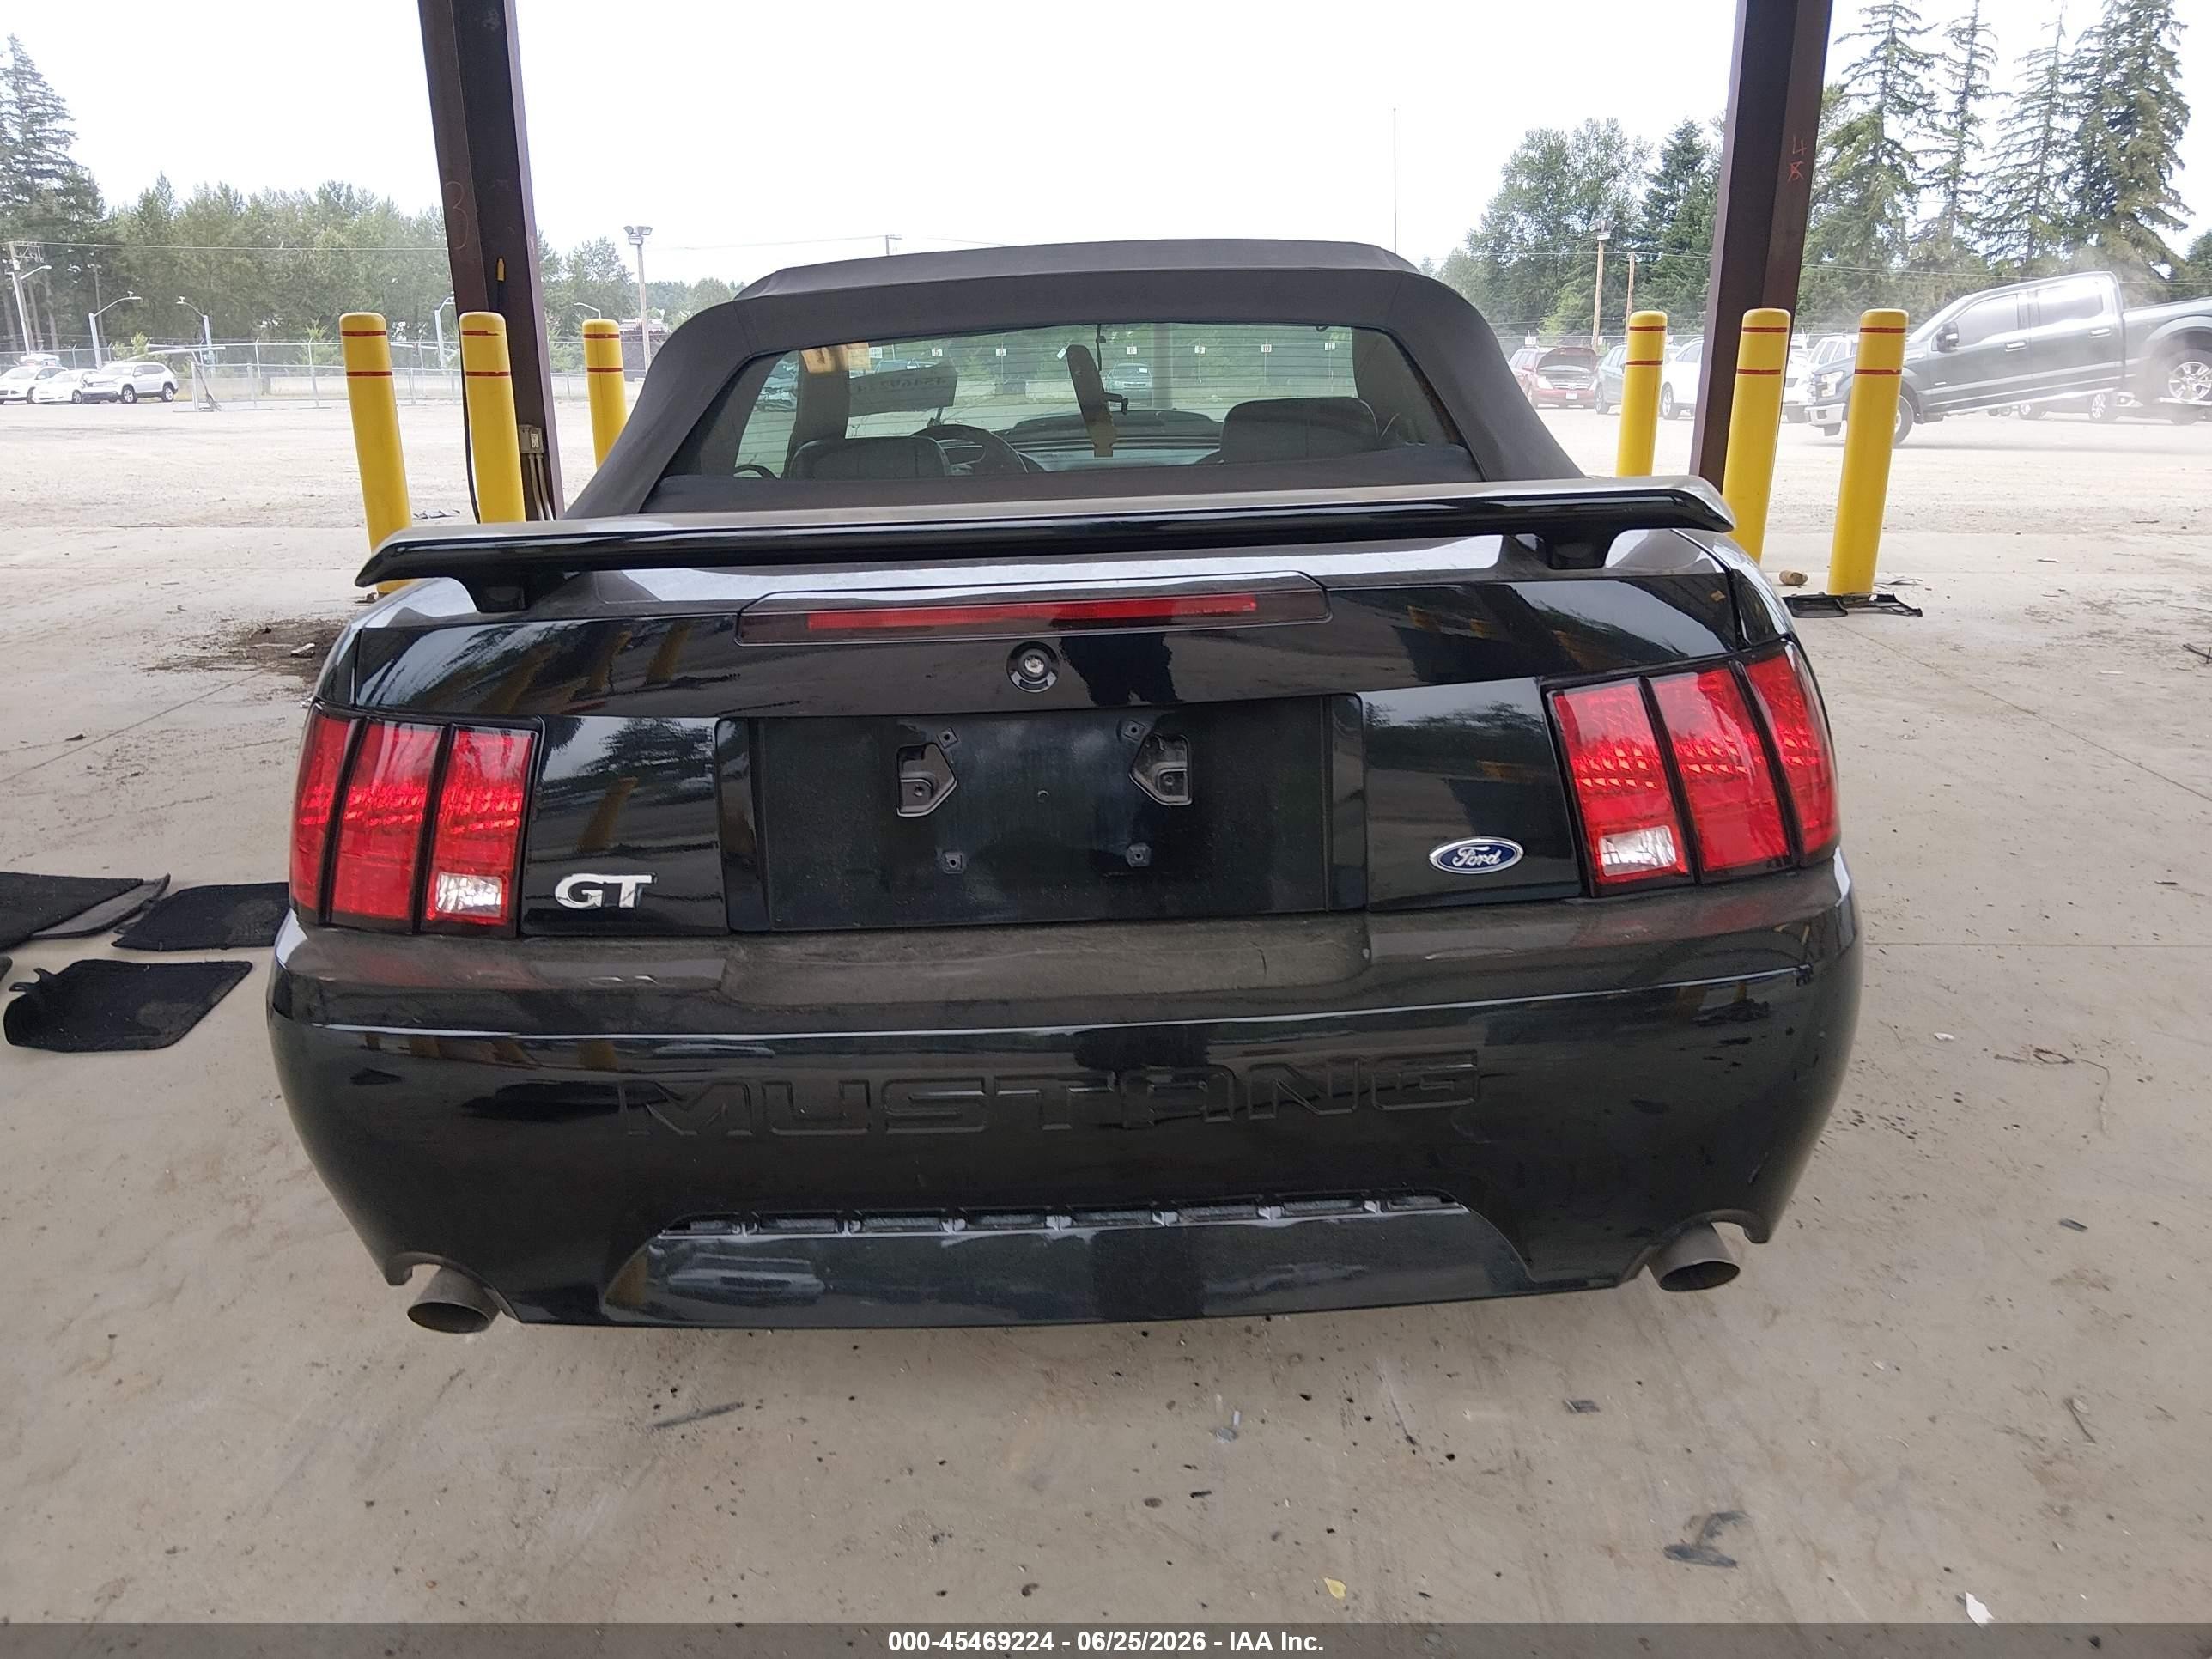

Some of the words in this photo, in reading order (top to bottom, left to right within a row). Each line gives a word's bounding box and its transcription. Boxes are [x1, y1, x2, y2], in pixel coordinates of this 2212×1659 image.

[1452, 846, 1502, 866] Ford
[555, 872, 658, 909] GT
[619, 1049, 1480, 1138] MUSTANG
